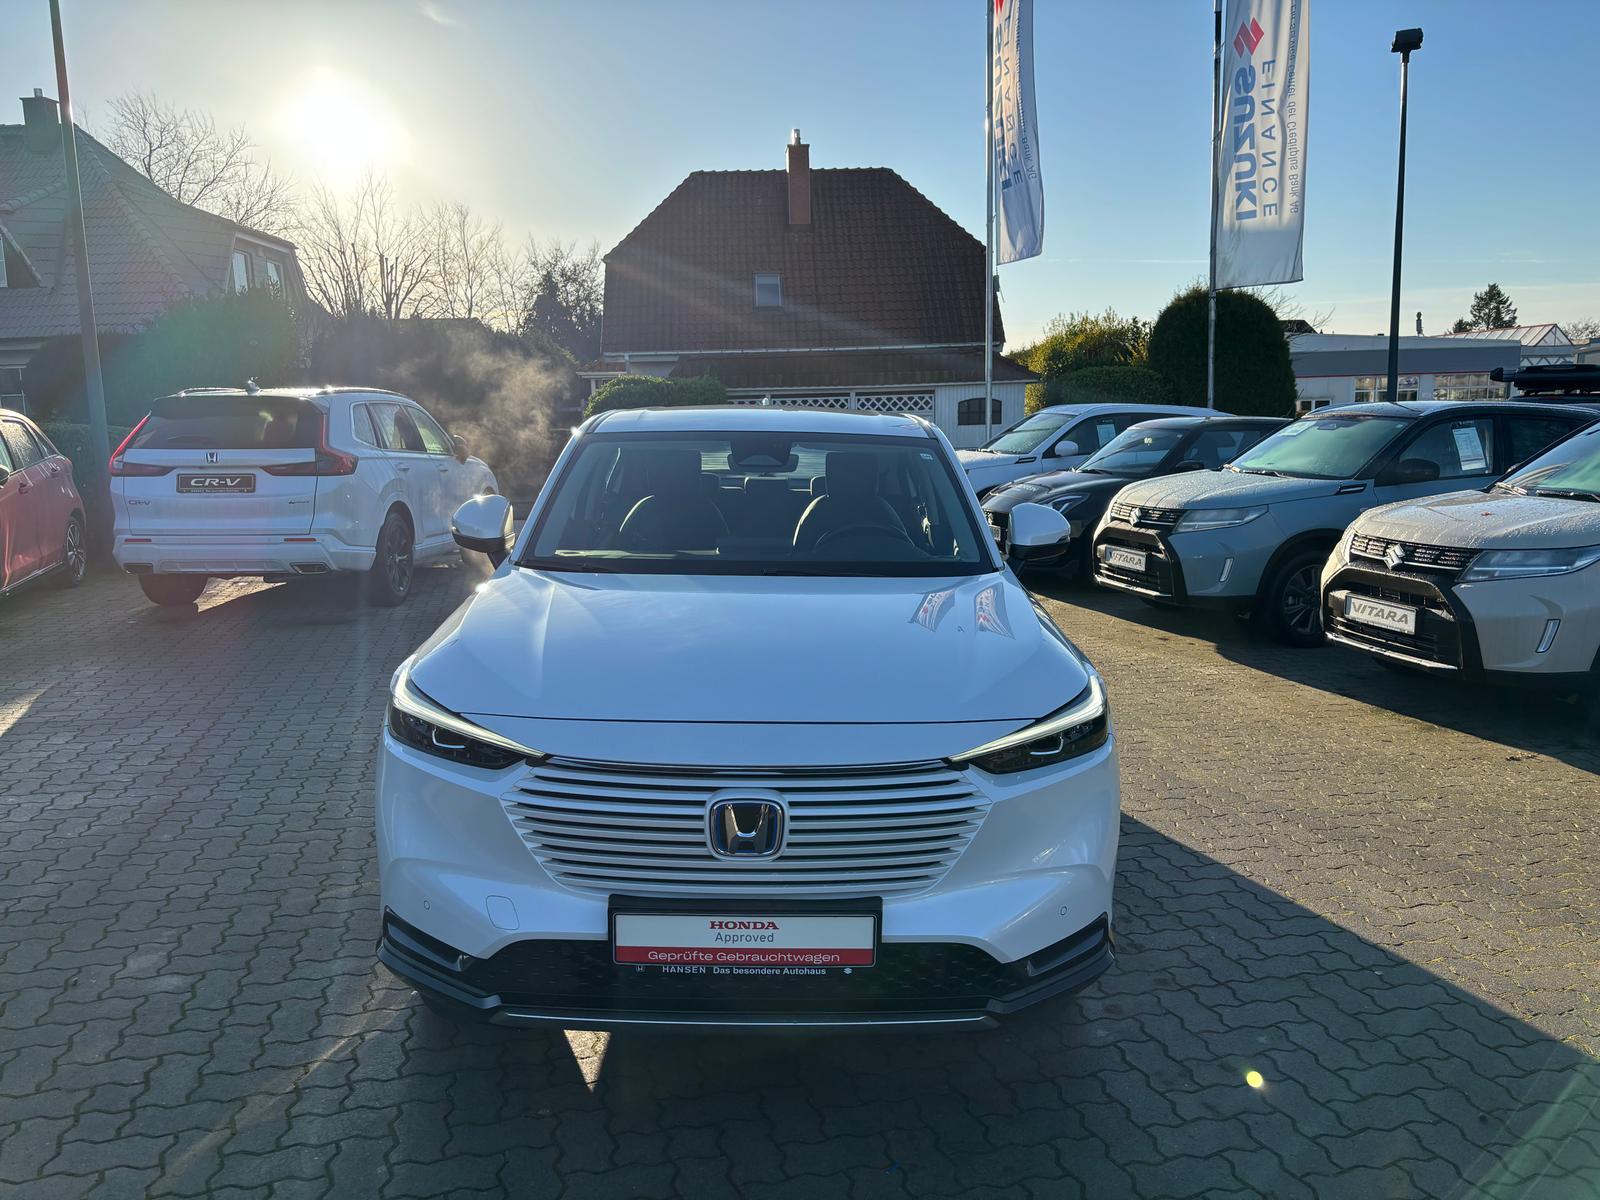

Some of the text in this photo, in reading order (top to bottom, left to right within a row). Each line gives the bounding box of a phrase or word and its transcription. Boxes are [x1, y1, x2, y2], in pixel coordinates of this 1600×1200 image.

[190, 478, 241, 486] CR-V
[1352, 602, 1409, 625] VITARA
[709, 920, 780, 930] HONDA
[714, 932, 775, 945] Approved
[648, 950, 840, 965] Geprüfte Gebrauchtwagen
[662, 965, 827, 975] HANSEN Das besondere Autohaus
